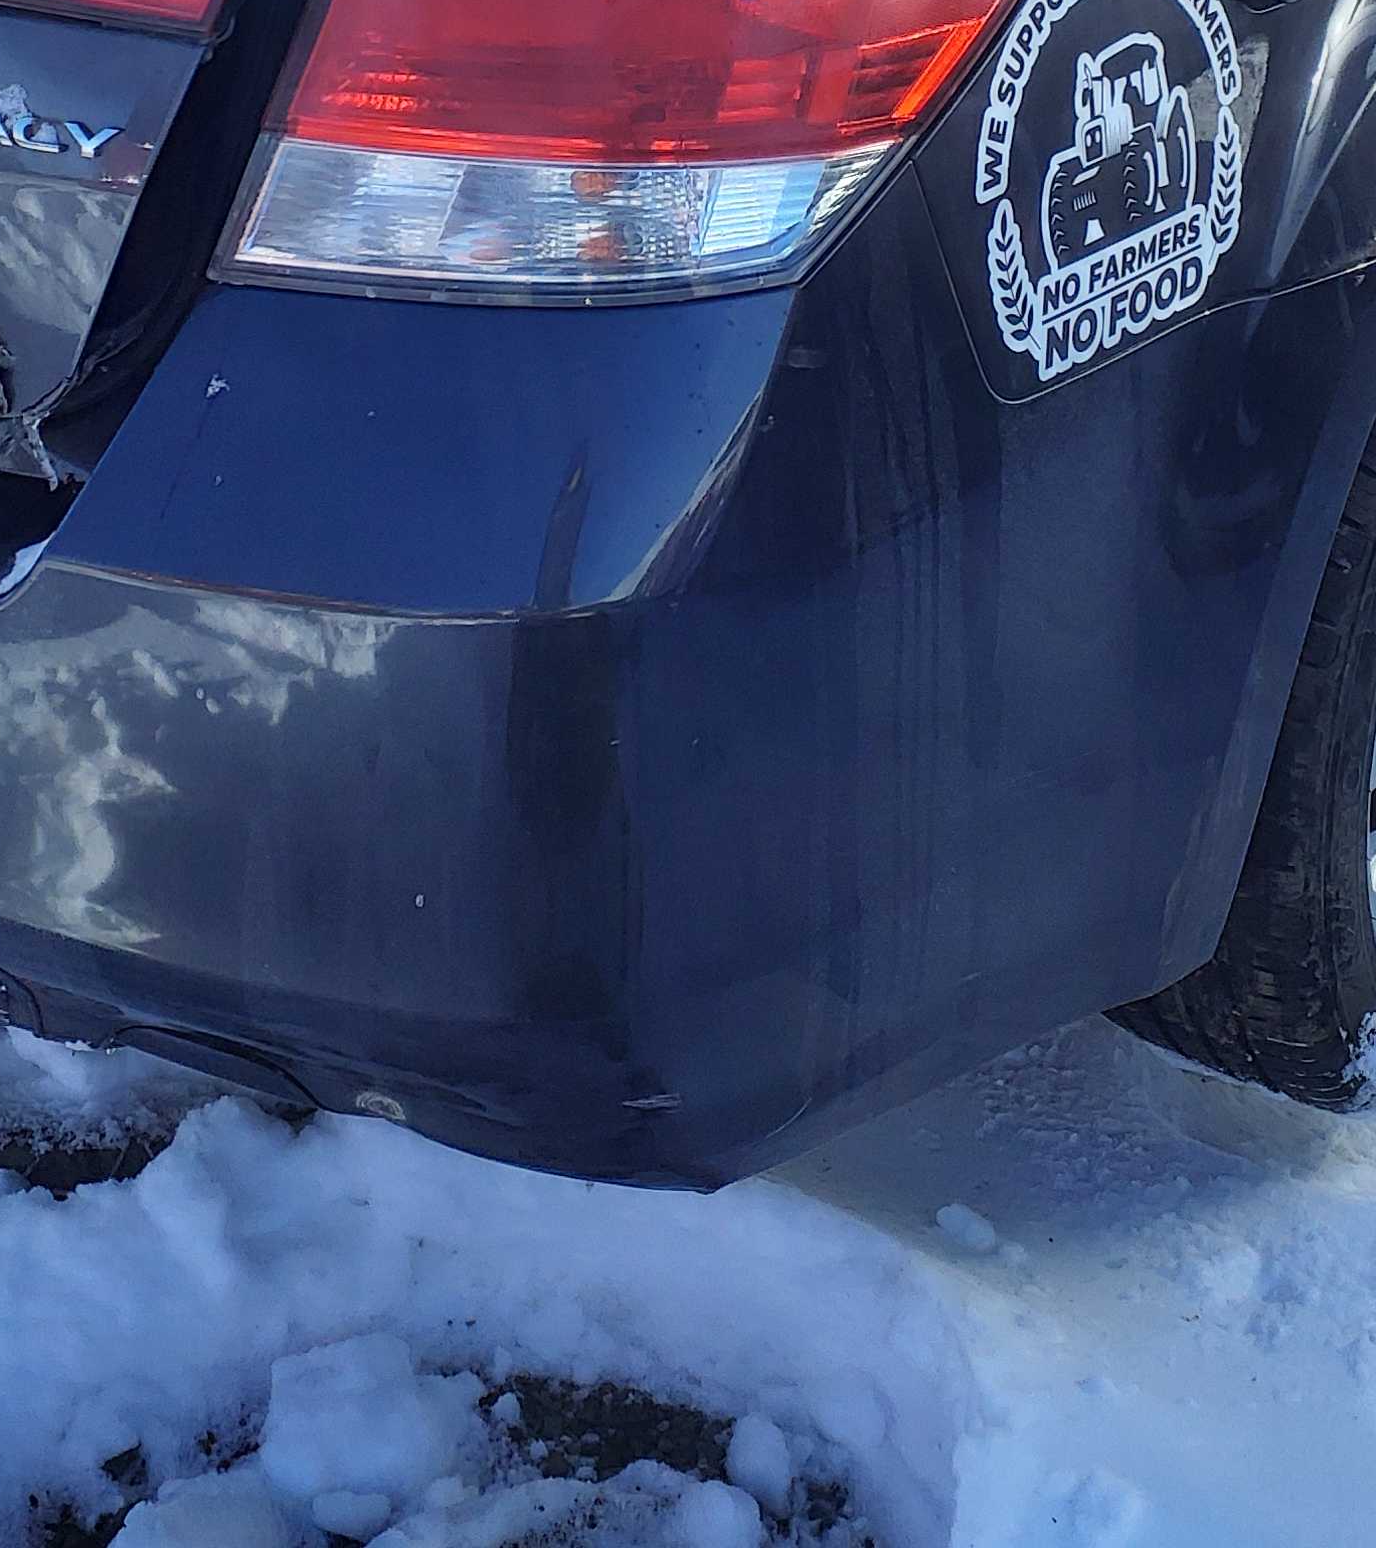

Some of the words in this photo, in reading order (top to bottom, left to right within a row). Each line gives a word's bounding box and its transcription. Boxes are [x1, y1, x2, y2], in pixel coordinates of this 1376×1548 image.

[983, 118, 1009, 192] WE
[1042, 273, 1080, 315] NO
[1089, 220, 1202, 289] FARMERS
[1044, 316, 1098, 371] NO
[1108, 256, 1204, 340] FOOD
